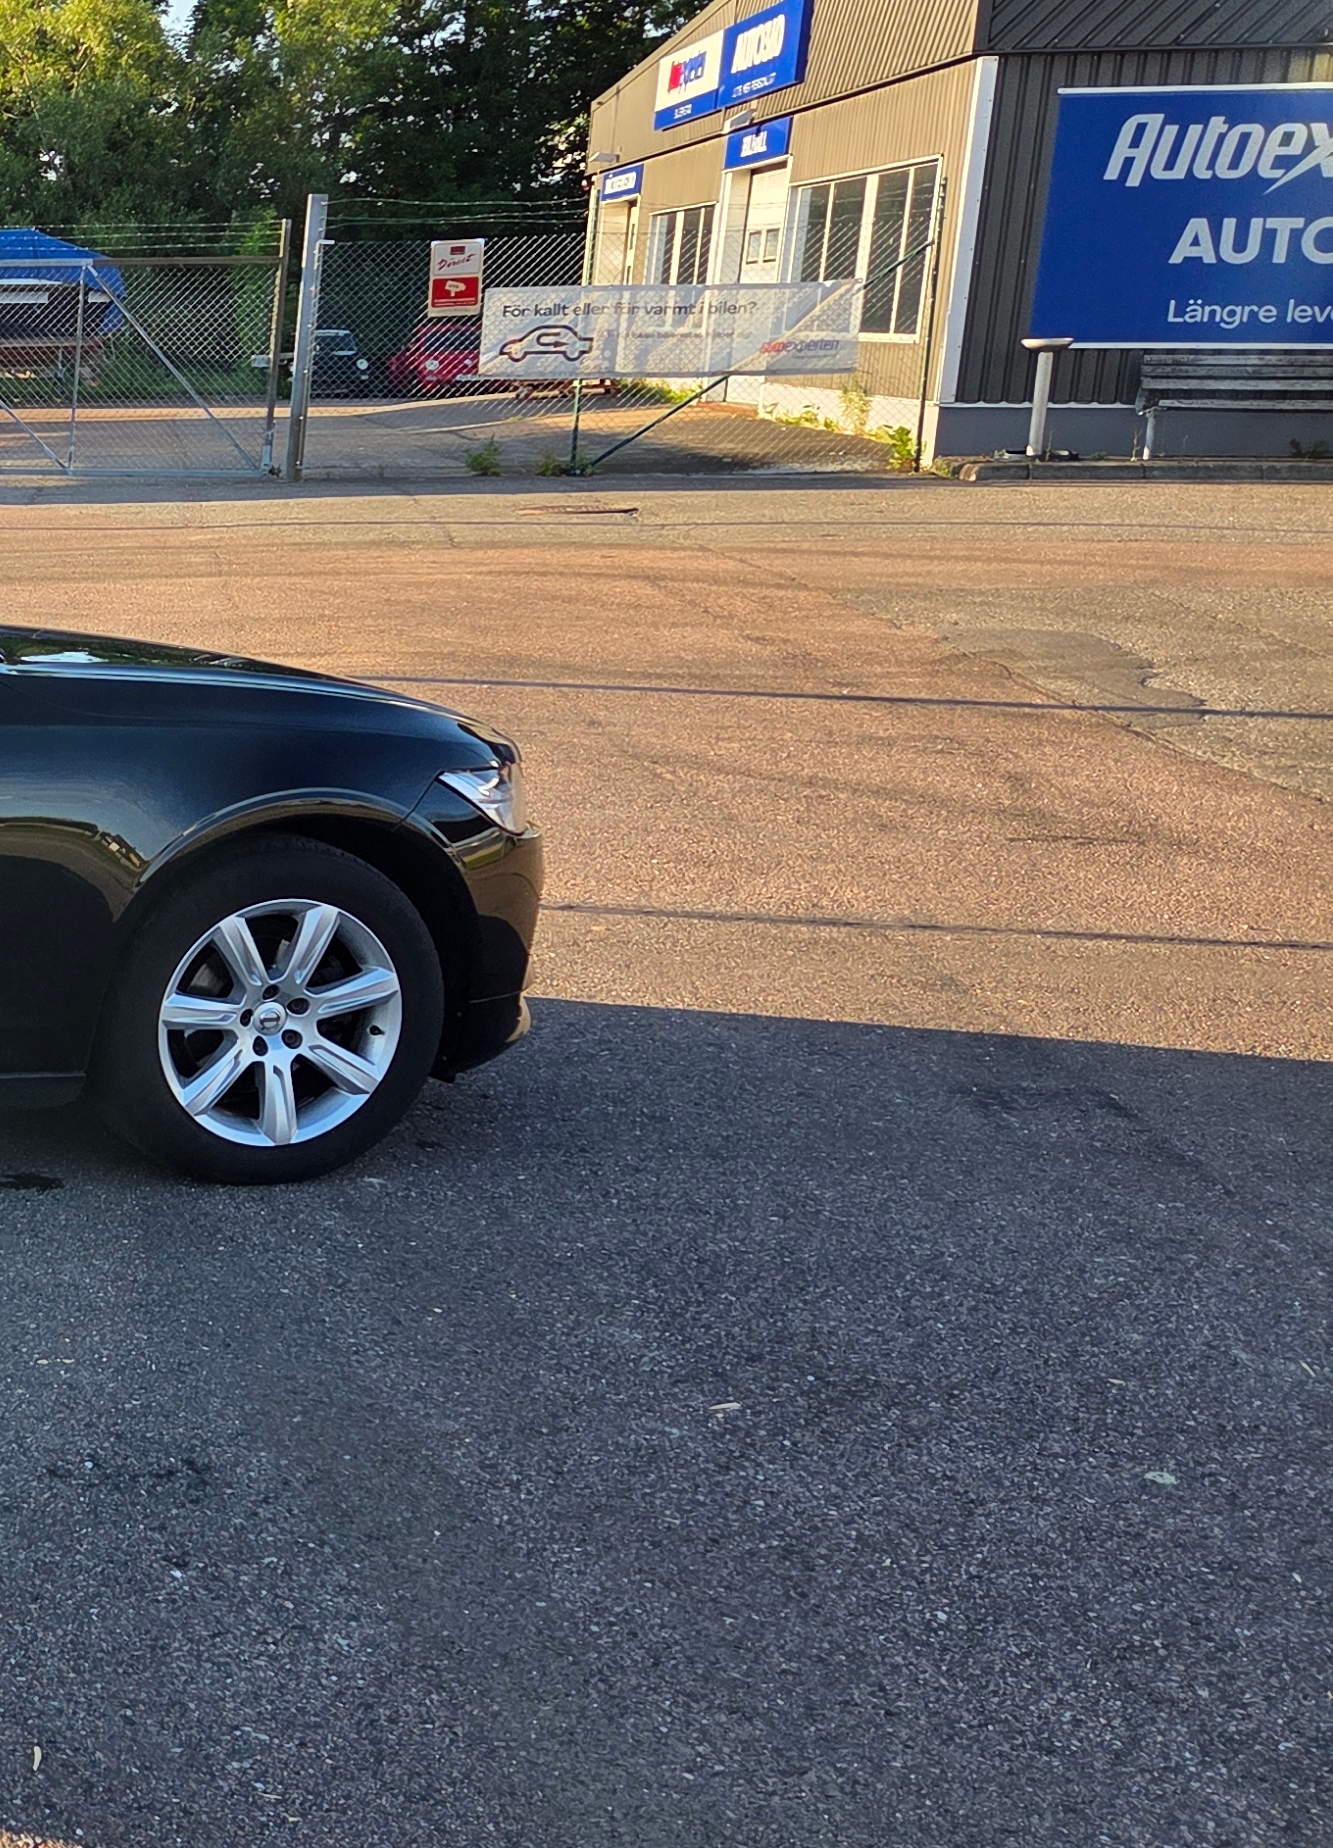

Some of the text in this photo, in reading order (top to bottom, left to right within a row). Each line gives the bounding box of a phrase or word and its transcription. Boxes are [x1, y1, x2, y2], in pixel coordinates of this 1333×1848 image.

[502, 304, 531, 318] För
[533, 303, 570, 317] kallt
[572, 302, 610, 316] eller
[1167, 299, 1333, 329] Längre lev
